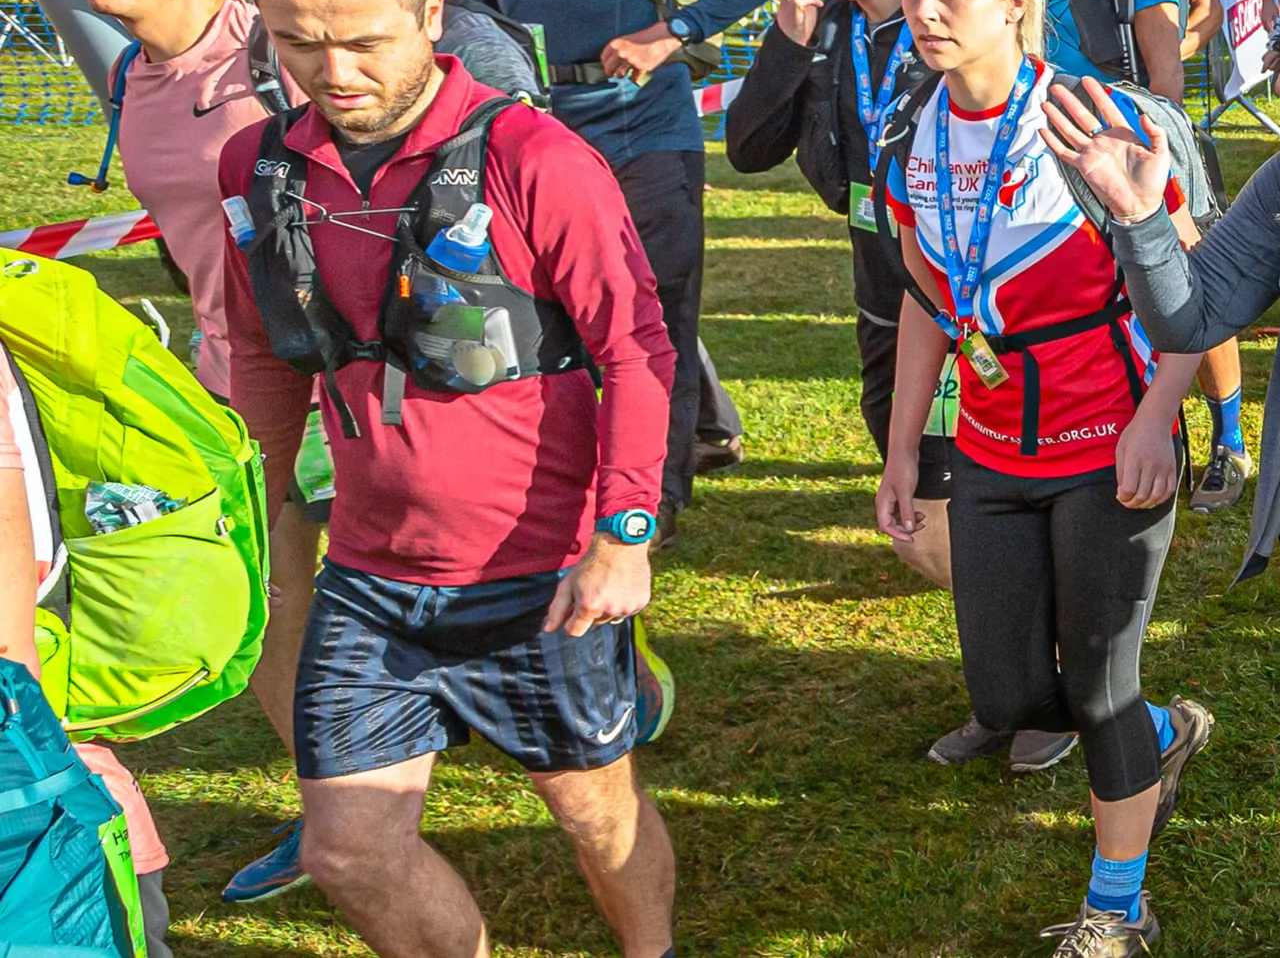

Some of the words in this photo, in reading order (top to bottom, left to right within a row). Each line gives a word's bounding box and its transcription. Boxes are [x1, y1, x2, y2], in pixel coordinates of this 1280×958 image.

[1006, 104, 1018, 121] 2022
[908, 156, 962, 175] Chilen
[964, 160, 992, 175] wit
[958, 177, 980, 193] UK
[984, 184, 994, 202] 2022
[961, 197, 980, 205] young
[966, 266, 978, 283] 2022
